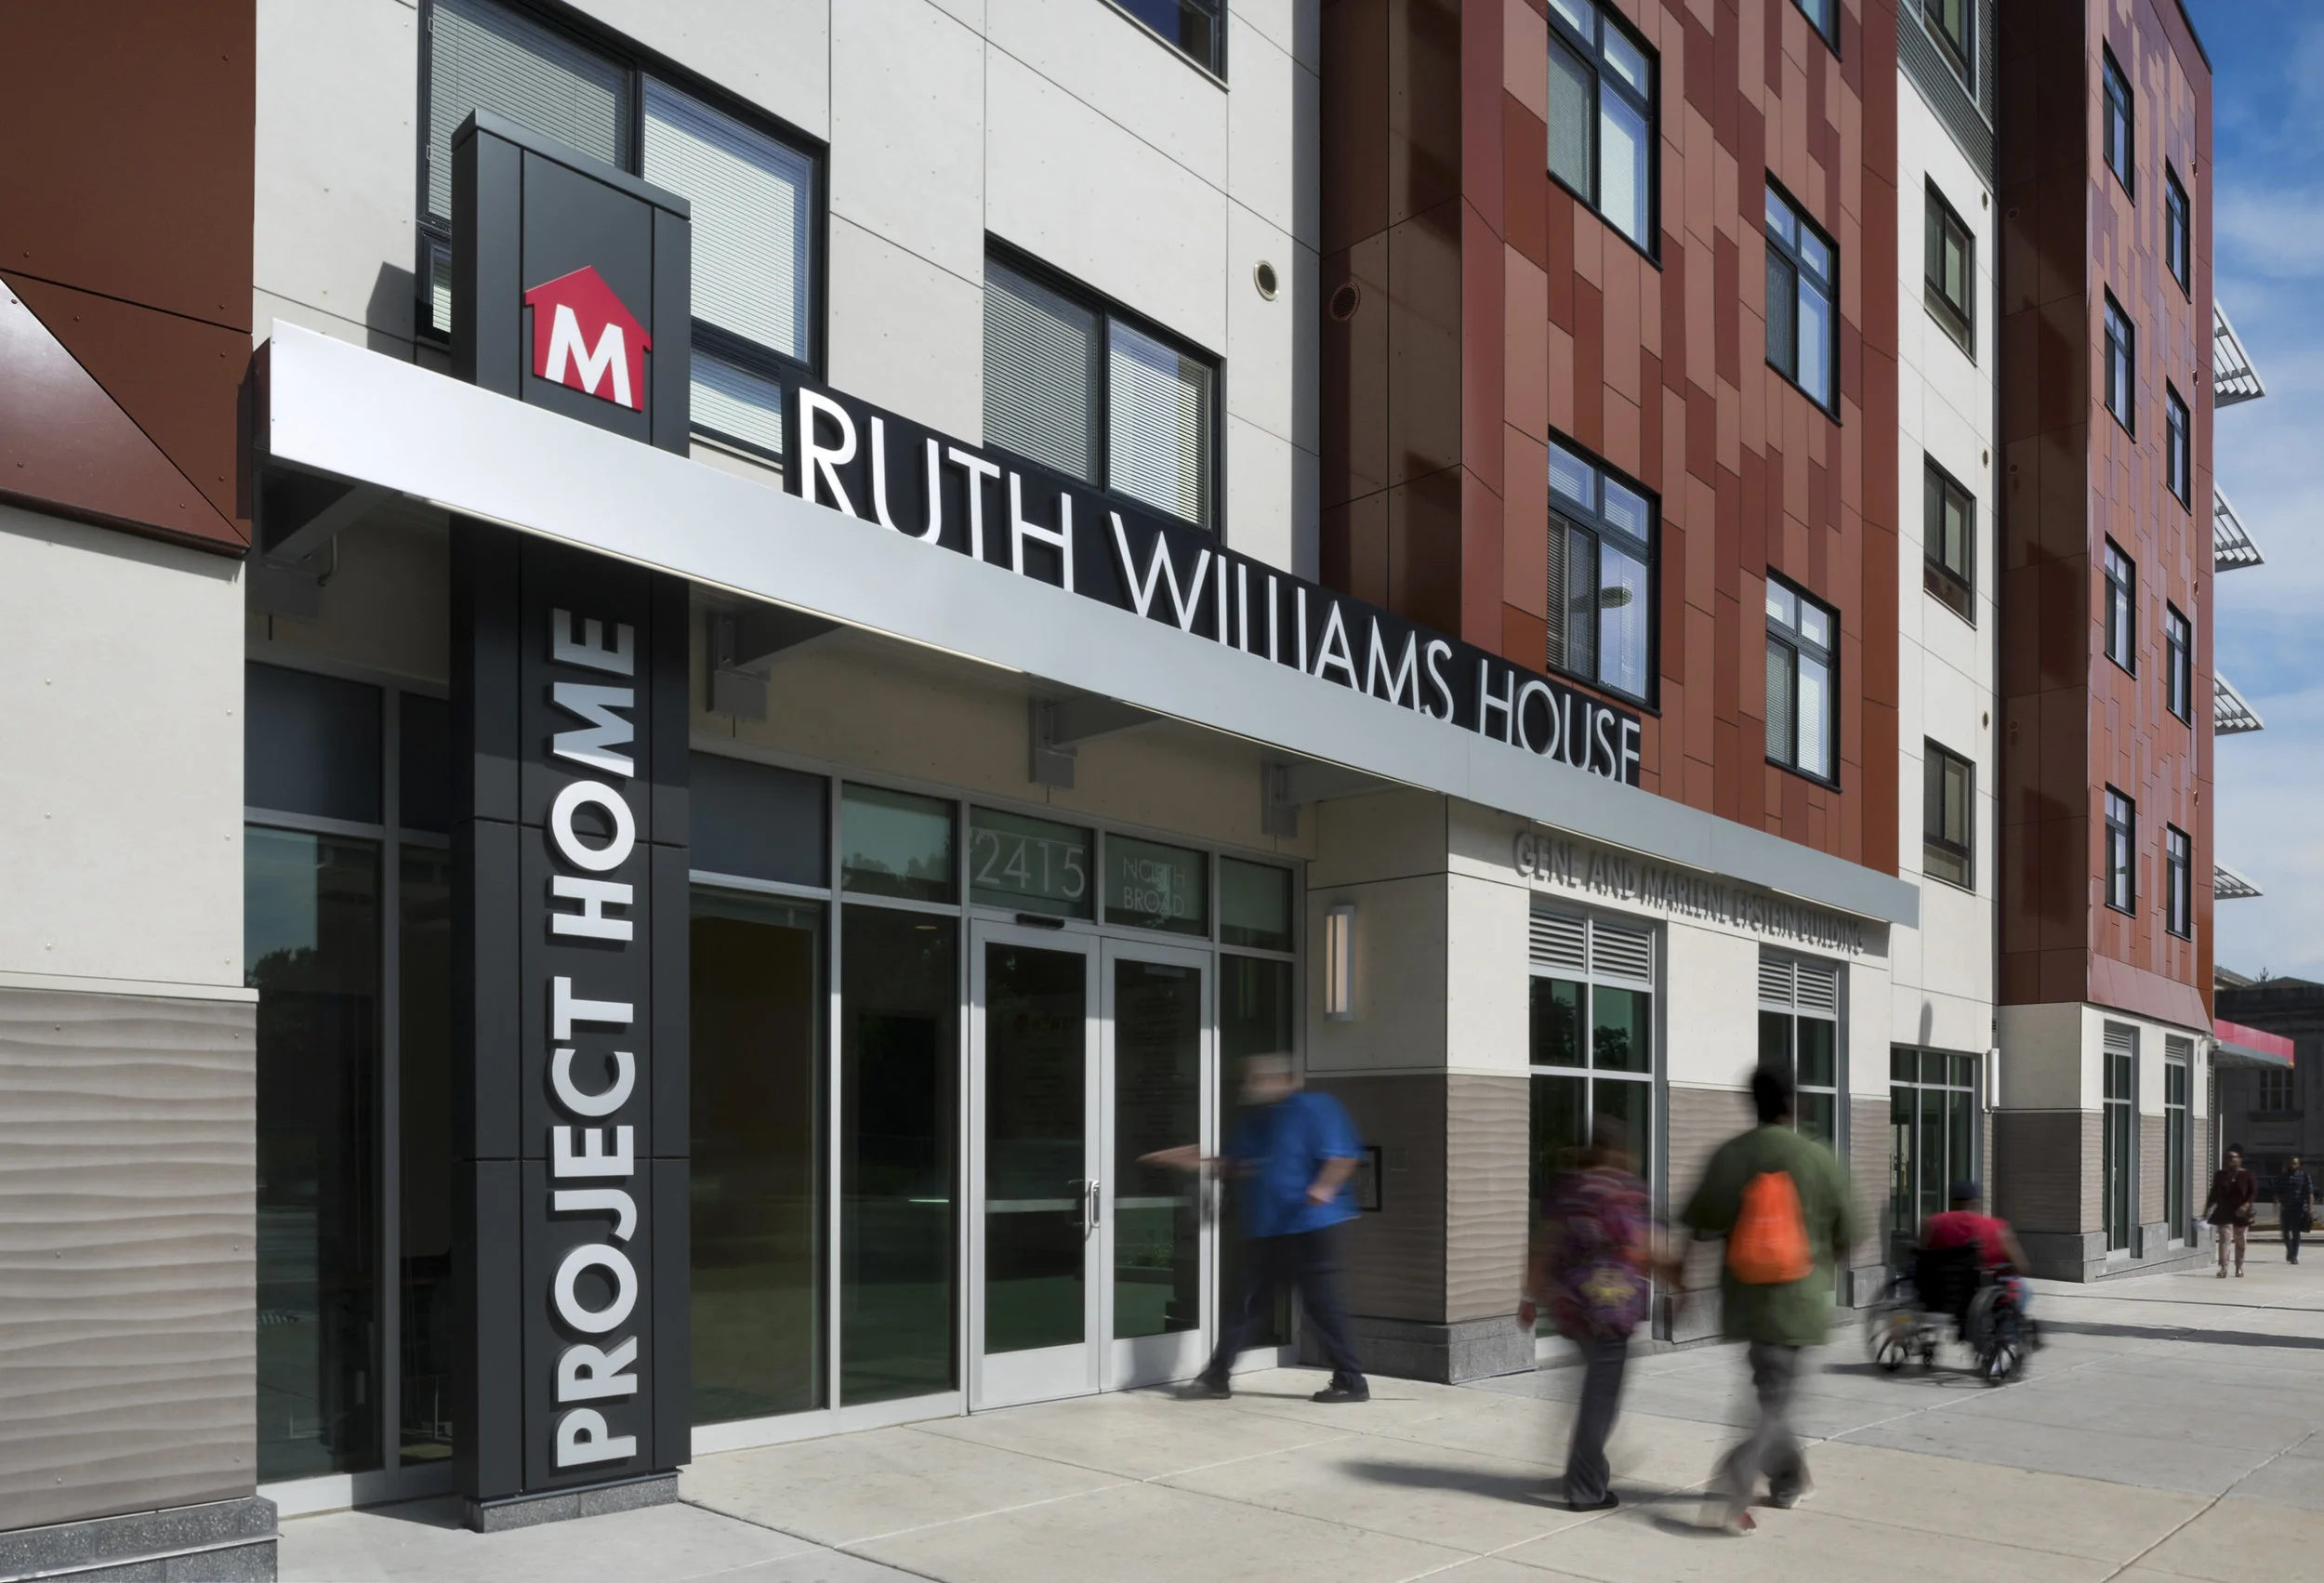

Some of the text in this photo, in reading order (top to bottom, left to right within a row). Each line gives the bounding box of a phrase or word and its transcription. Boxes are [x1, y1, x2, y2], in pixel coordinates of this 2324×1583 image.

[545, 303, 633, 408] M
[799, 387, 1641, 785] RUTH WILLIAMS HOUSE
[974, 828, 1086, 898] 2415
[1123, 855, 1186, 888] NORTH
[1512, 830, 1581, 890] GENE
[1585, 849, 1637, 901] AND
[1124, 885, 1185, 917] BROAD
[550, 607, 639, 1469] PROJECT HOME
